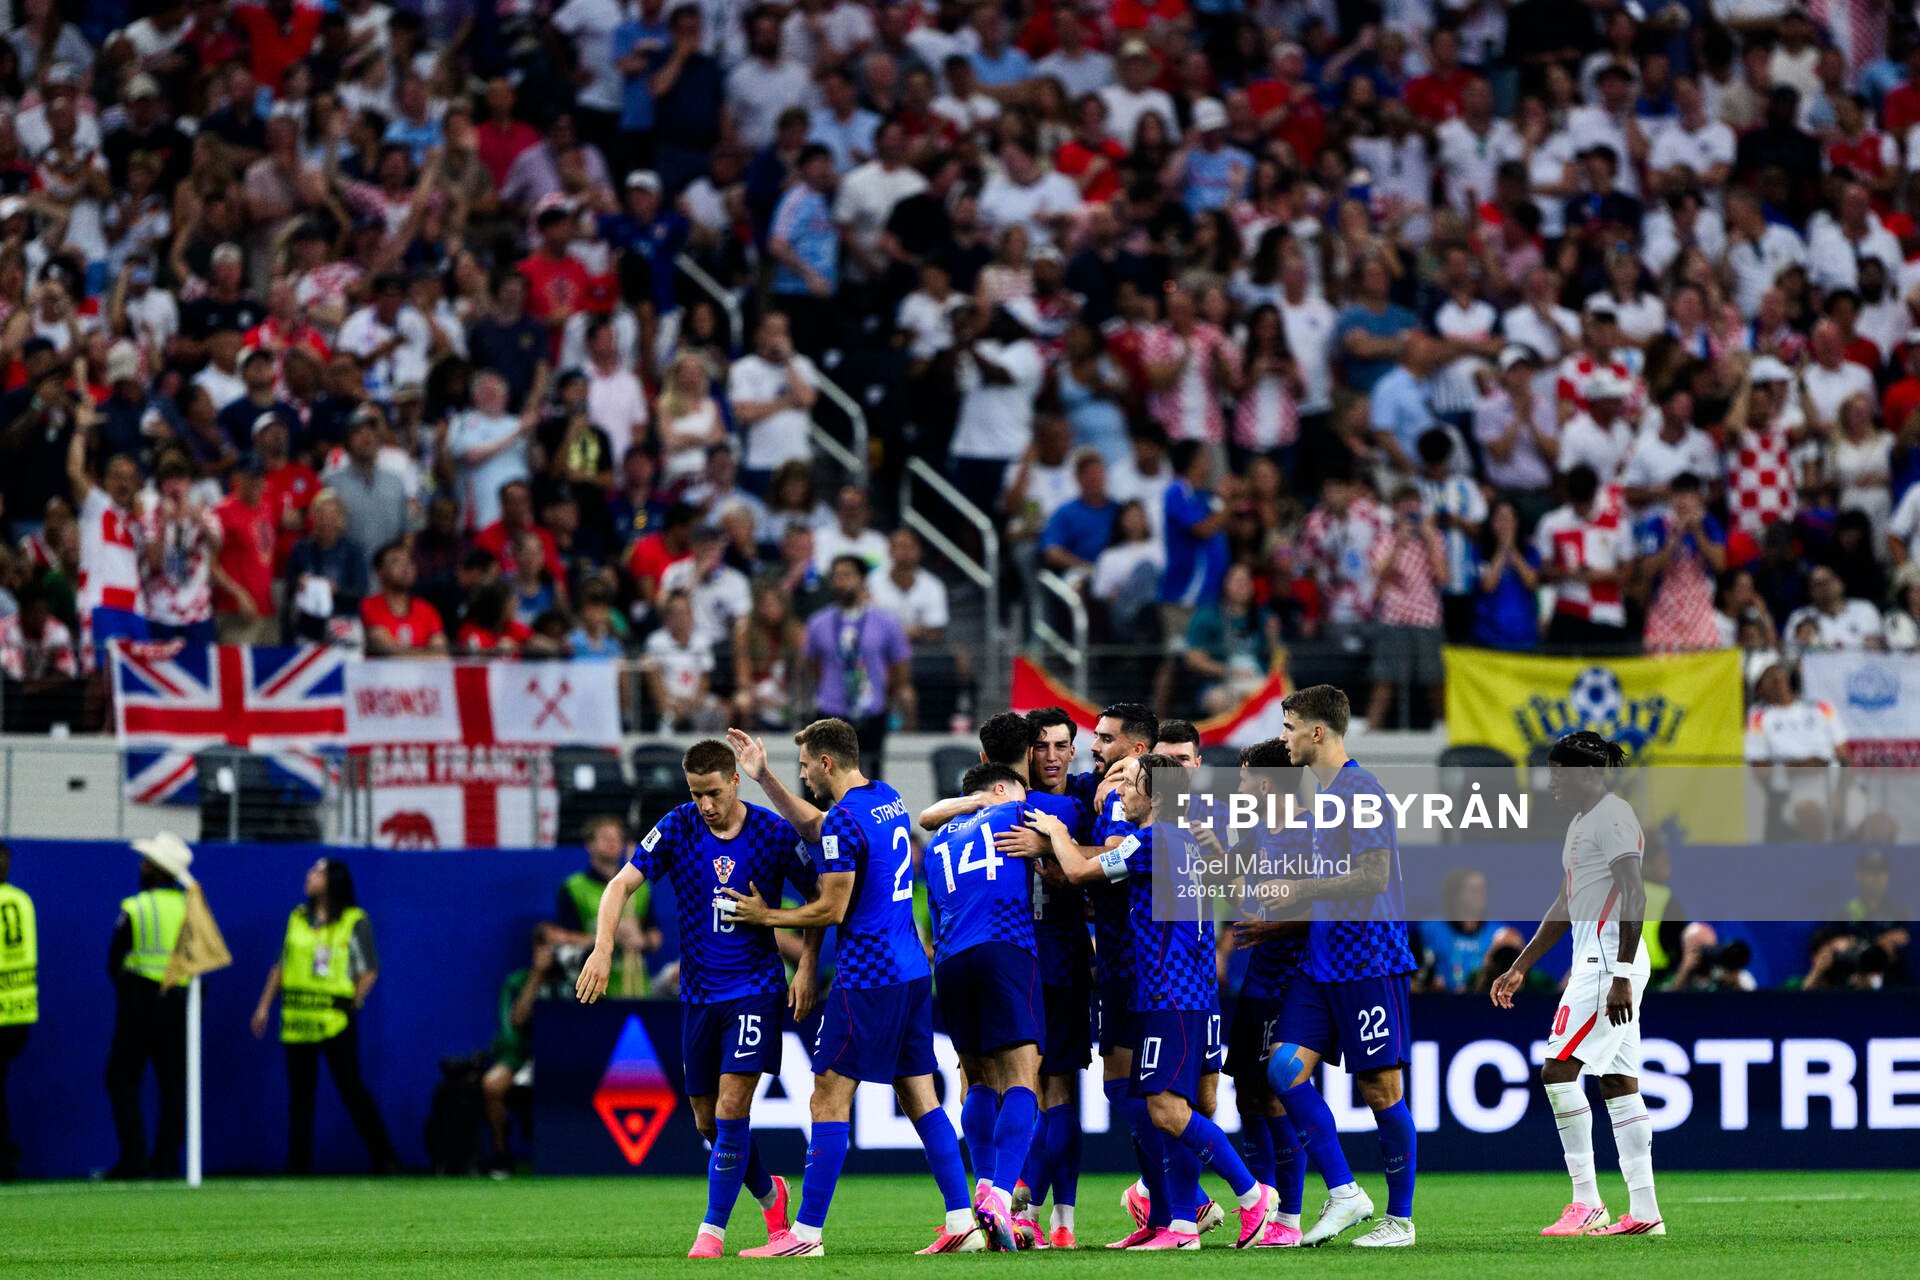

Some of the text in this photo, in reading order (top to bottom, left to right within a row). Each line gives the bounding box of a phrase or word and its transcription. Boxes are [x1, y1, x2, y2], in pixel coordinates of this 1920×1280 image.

[892, 826, 912, 902] 2
[933, 822, 1004, 894] 14
[738, 1014, 762, 1046] 15
[1207, 1015, 1221, 1046] 17
[1358, 1006, 1390, 1042] 22
[1141, 1037, 1162, 1069] 10
